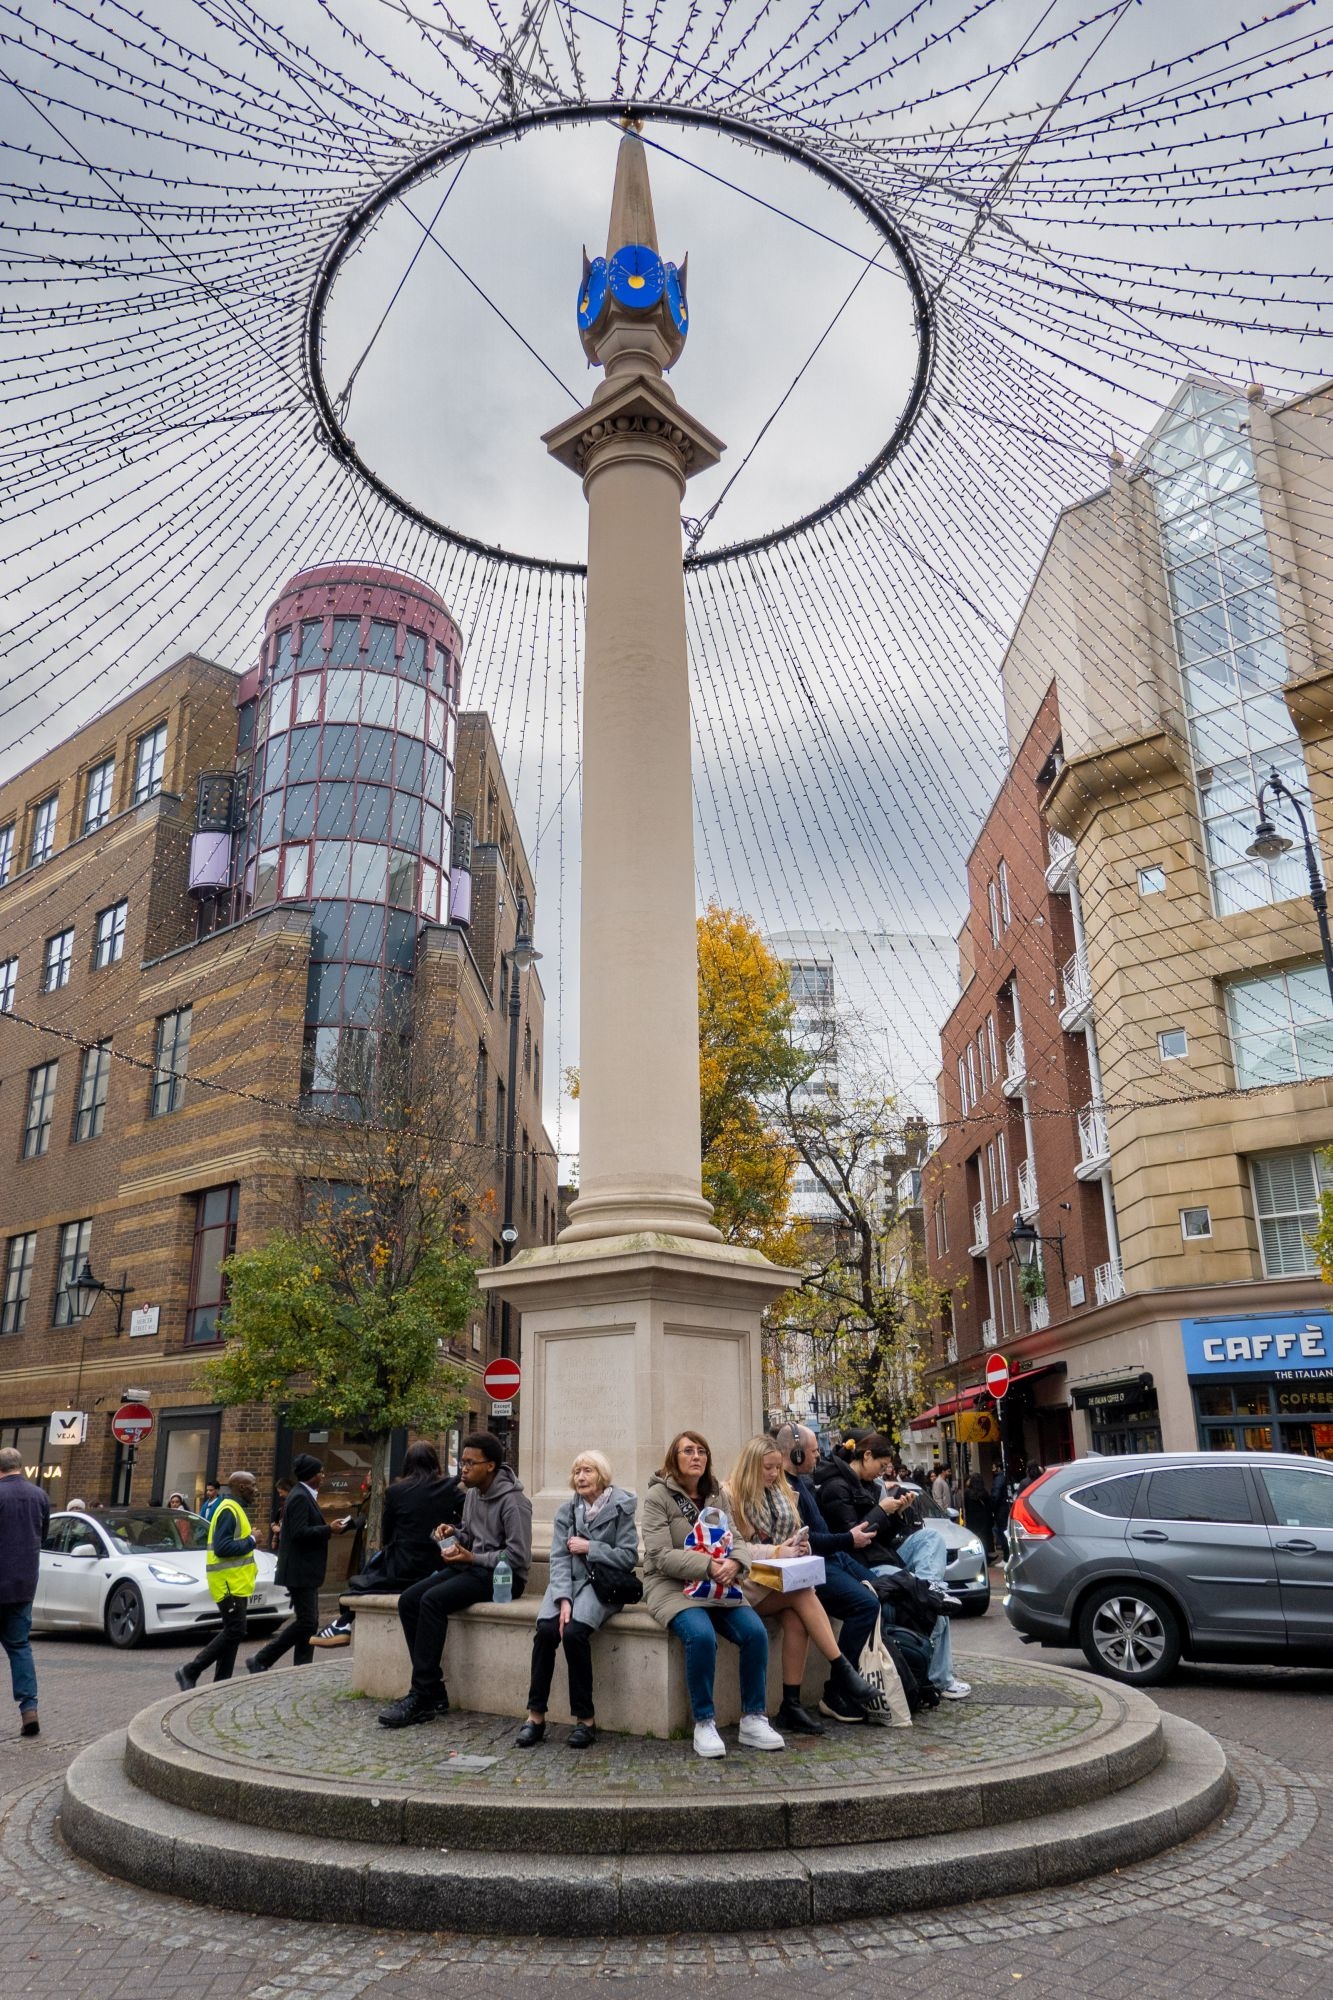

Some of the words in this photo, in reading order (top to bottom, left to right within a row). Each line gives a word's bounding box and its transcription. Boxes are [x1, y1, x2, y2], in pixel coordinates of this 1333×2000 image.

[1203, 1324, 1326, 1361] CAFFÈ
[1275, 1371, 1293, 1379] THE
[1295, 1369, 1333, 1378] ITALIAN
[1280, 1392, 1333, 1404] COFFEE
